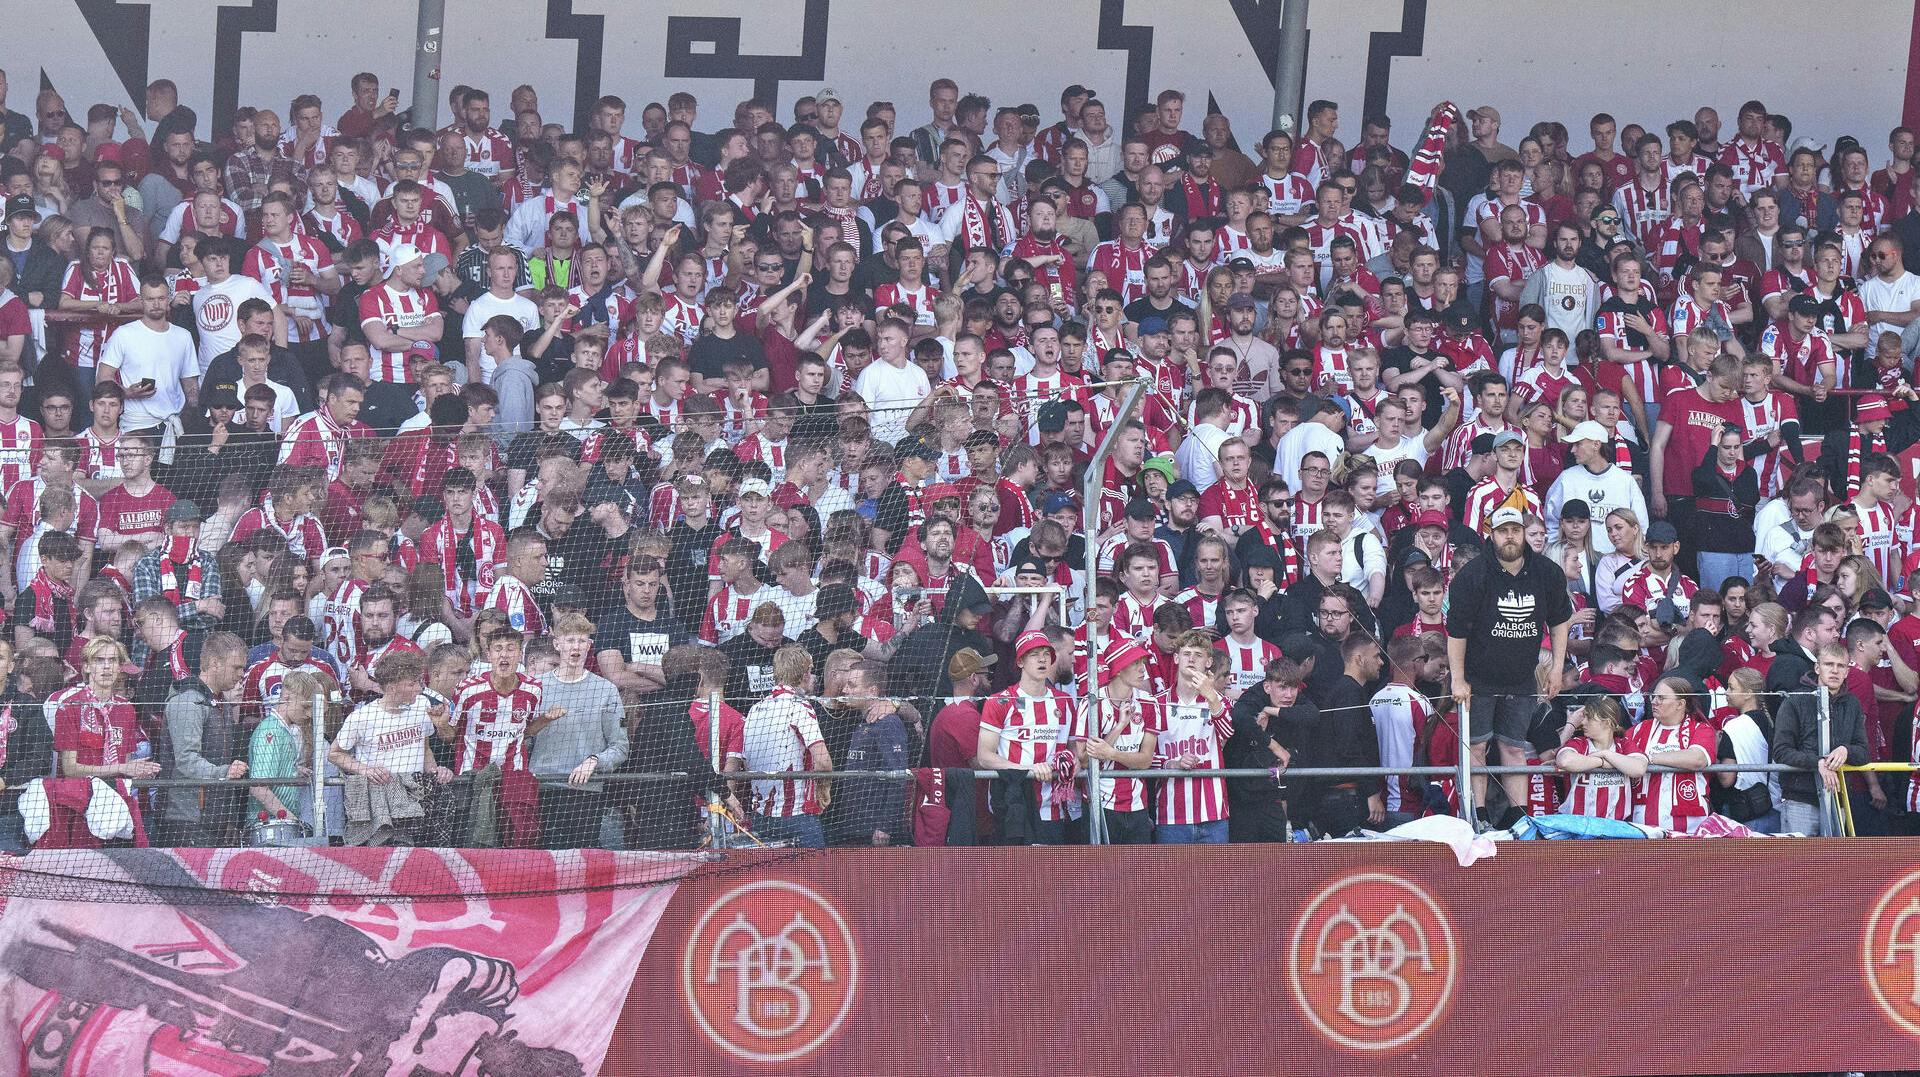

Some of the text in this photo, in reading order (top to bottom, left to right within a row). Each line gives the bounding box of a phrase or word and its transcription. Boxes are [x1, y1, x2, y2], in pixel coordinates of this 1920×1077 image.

[1549, 282, 1587, 297] HILFIGER
[119, 511, 162, 525] AALBORG
[1494, 621, 1536, 632] AALBORG
[1491, 628, 1538, 639] ORIGINALS
[378, 725, 422, 745] AALBORG
[486, 729, 508, 739] spar
